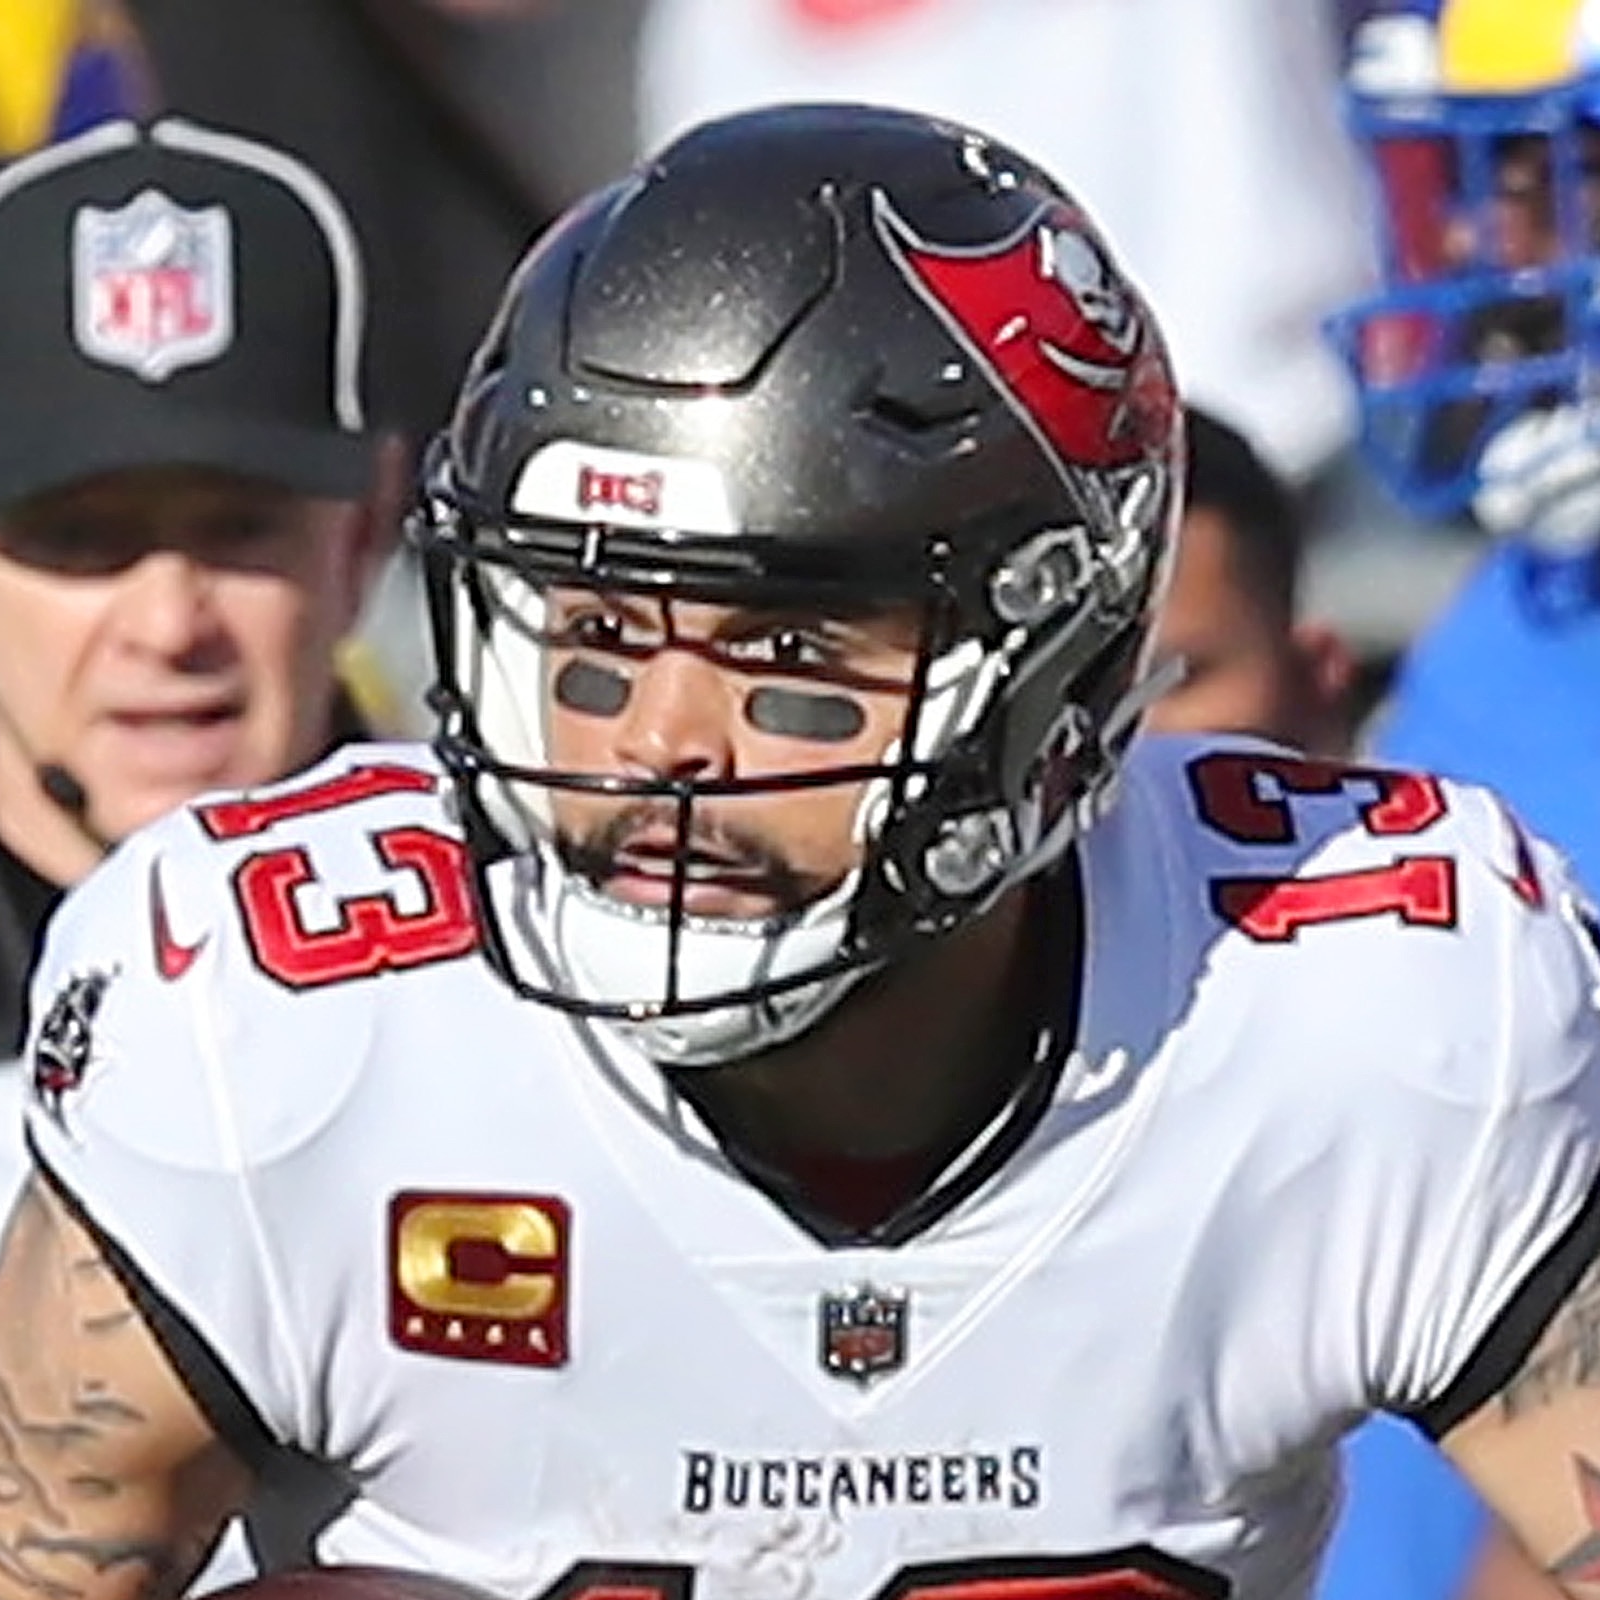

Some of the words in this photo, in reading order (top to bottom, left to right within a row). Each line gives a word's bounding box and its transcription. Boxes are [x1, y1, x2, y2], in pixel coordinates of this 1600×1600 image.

[193, 763, 485, 993] 13
[1186, 751, 1460, 943] 13
[399, 1202, 559, 1319] C
